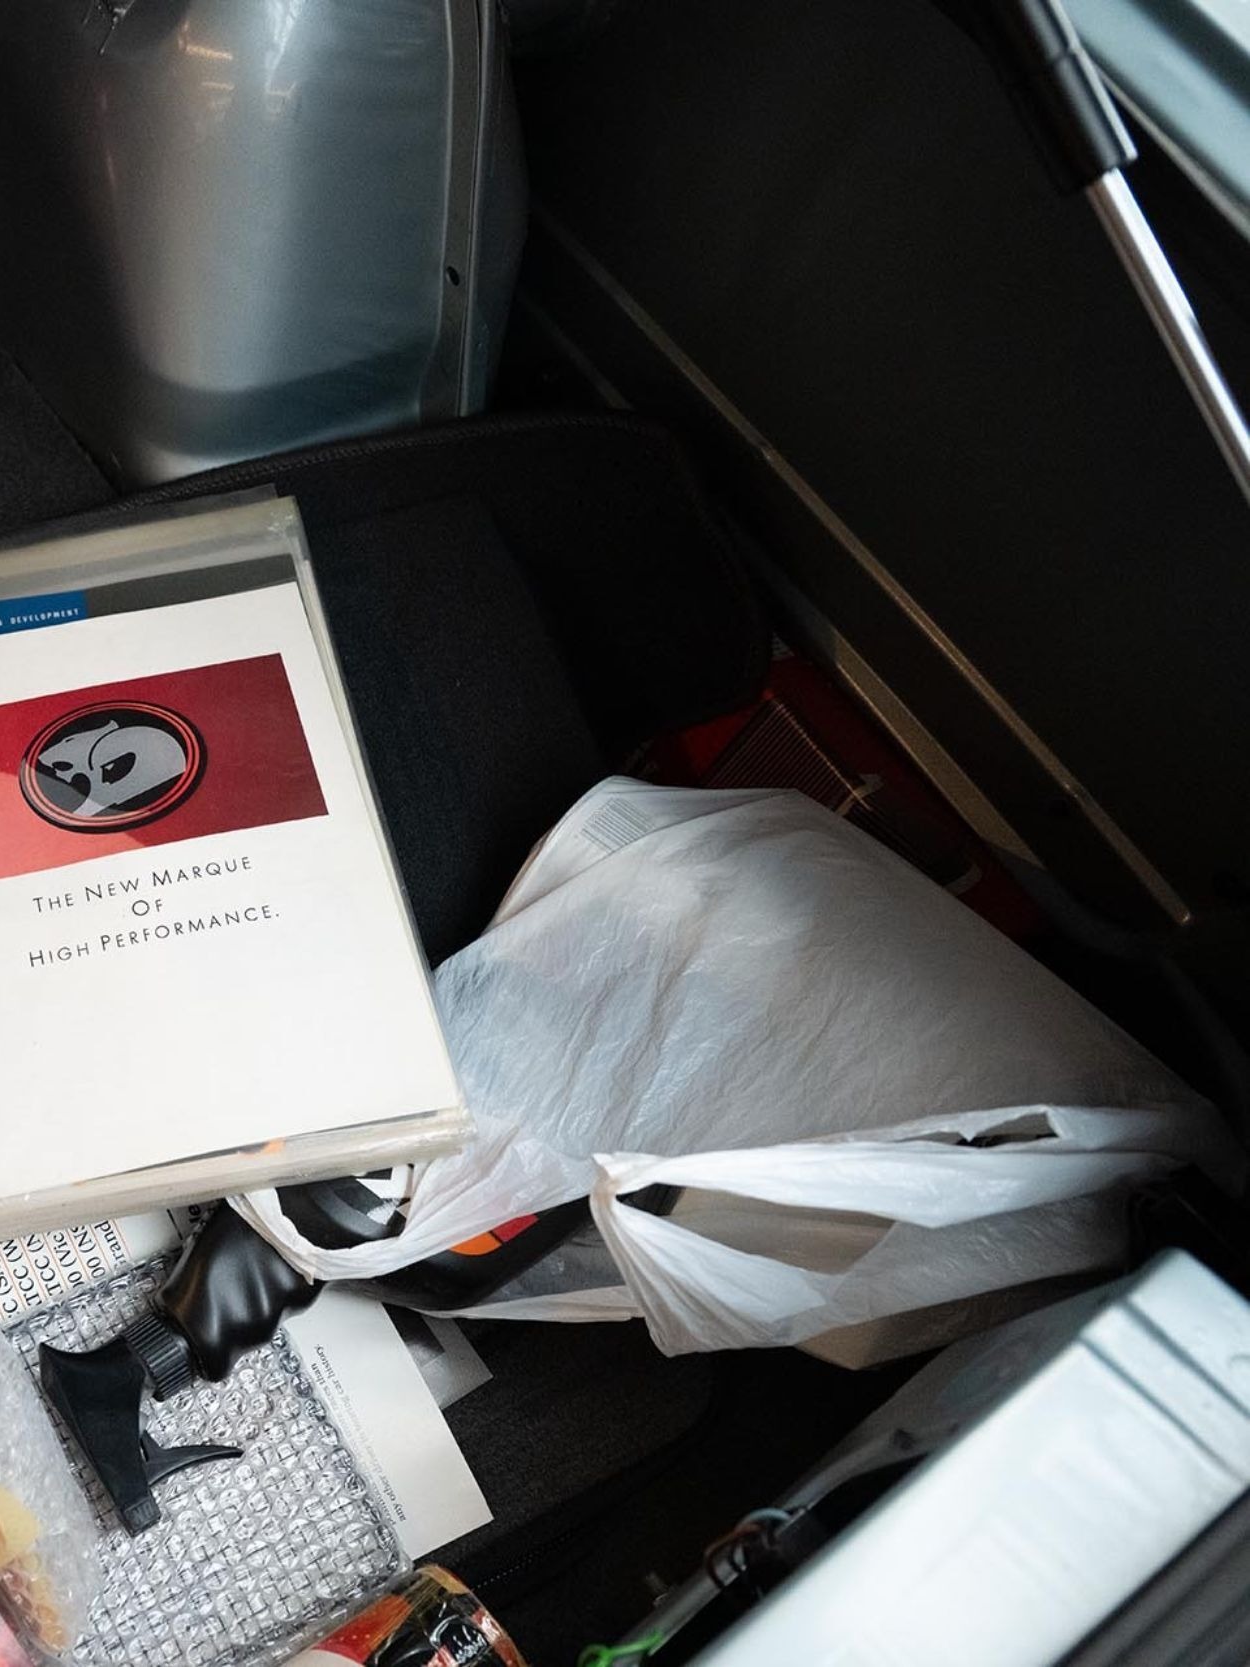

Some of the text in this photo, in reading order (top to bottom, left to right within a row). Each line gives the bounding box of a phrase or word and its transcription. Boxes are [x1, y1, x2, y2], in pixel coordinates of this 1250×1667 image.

[10, 608, 80, 625] DEVELOPMENT
[32, 856, 252, 914] THE NEW MARQUE
[131, 898, 164, 917] OF
[29, 904, 280, 968] HIGH PERFORMANCE.
[94, 1220, 127, 1272] rand
[13, 1265, 43, 1307] TCC
[34, 1255, 64, 1297] TCC
[311, 1363, 326, 1385] than
